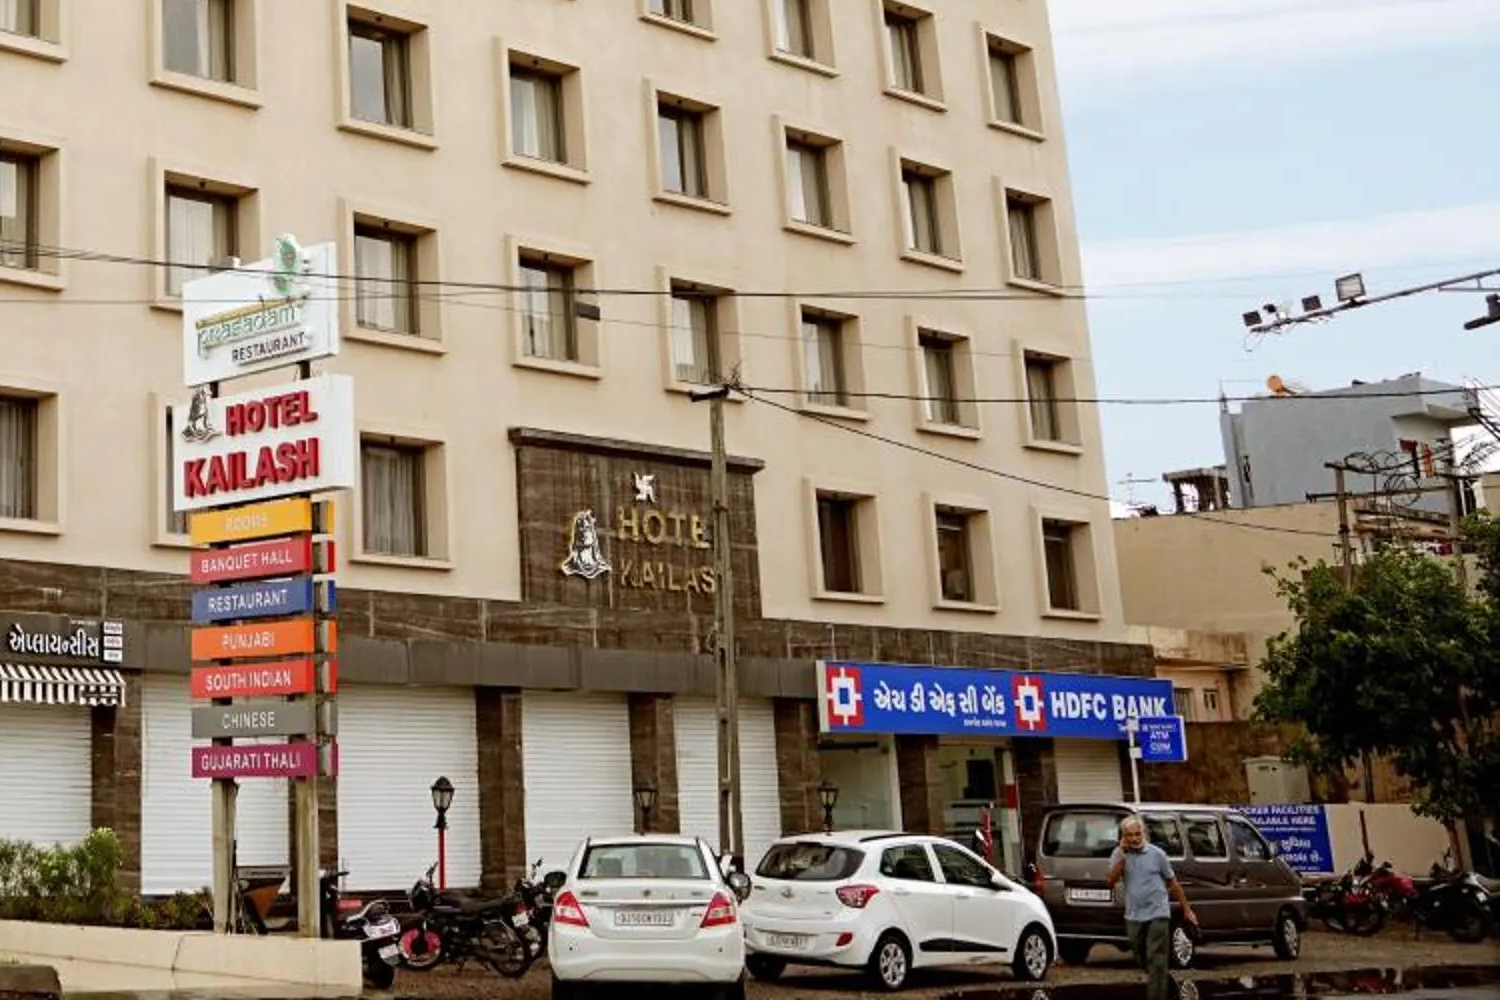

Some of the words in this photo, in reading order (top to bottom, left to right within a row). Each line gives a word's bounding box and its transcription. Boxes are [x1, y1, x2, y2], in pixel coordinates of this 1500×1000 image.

[231, 331, 305, 360] RESTAURANT
[225, 390, 319, 437] HOTEL
[184, 438, 320, 499] KAILASH
[616, 505, 711, 549] HOTE
[201, 553, 257, 574] BANQUET
[261, 547, 292, 566] HALL
[619, 559, 716, 594] KAILAS
[207, 589, 287, 613] RESTAURANT
[221, 632, 275, 650] PUNJABI
[205, 673, 246, 691] SOUTH
[249, 670, 291, 688] INDIAN
[873, 680, 906, 711] એચ
[910, 682, 926, 712] ડી
[928, 682, 956, 717] એફ
[958, 684, 978, 714] સી
[1050, 691, 1106, 719] HDFC
[1112, 694, 1167, 720] BANK
[222, 711, 275, 729] CHINESE
[201, 752, 261, 770] GUJARATI
[264, 750, 300, 769] THALI
